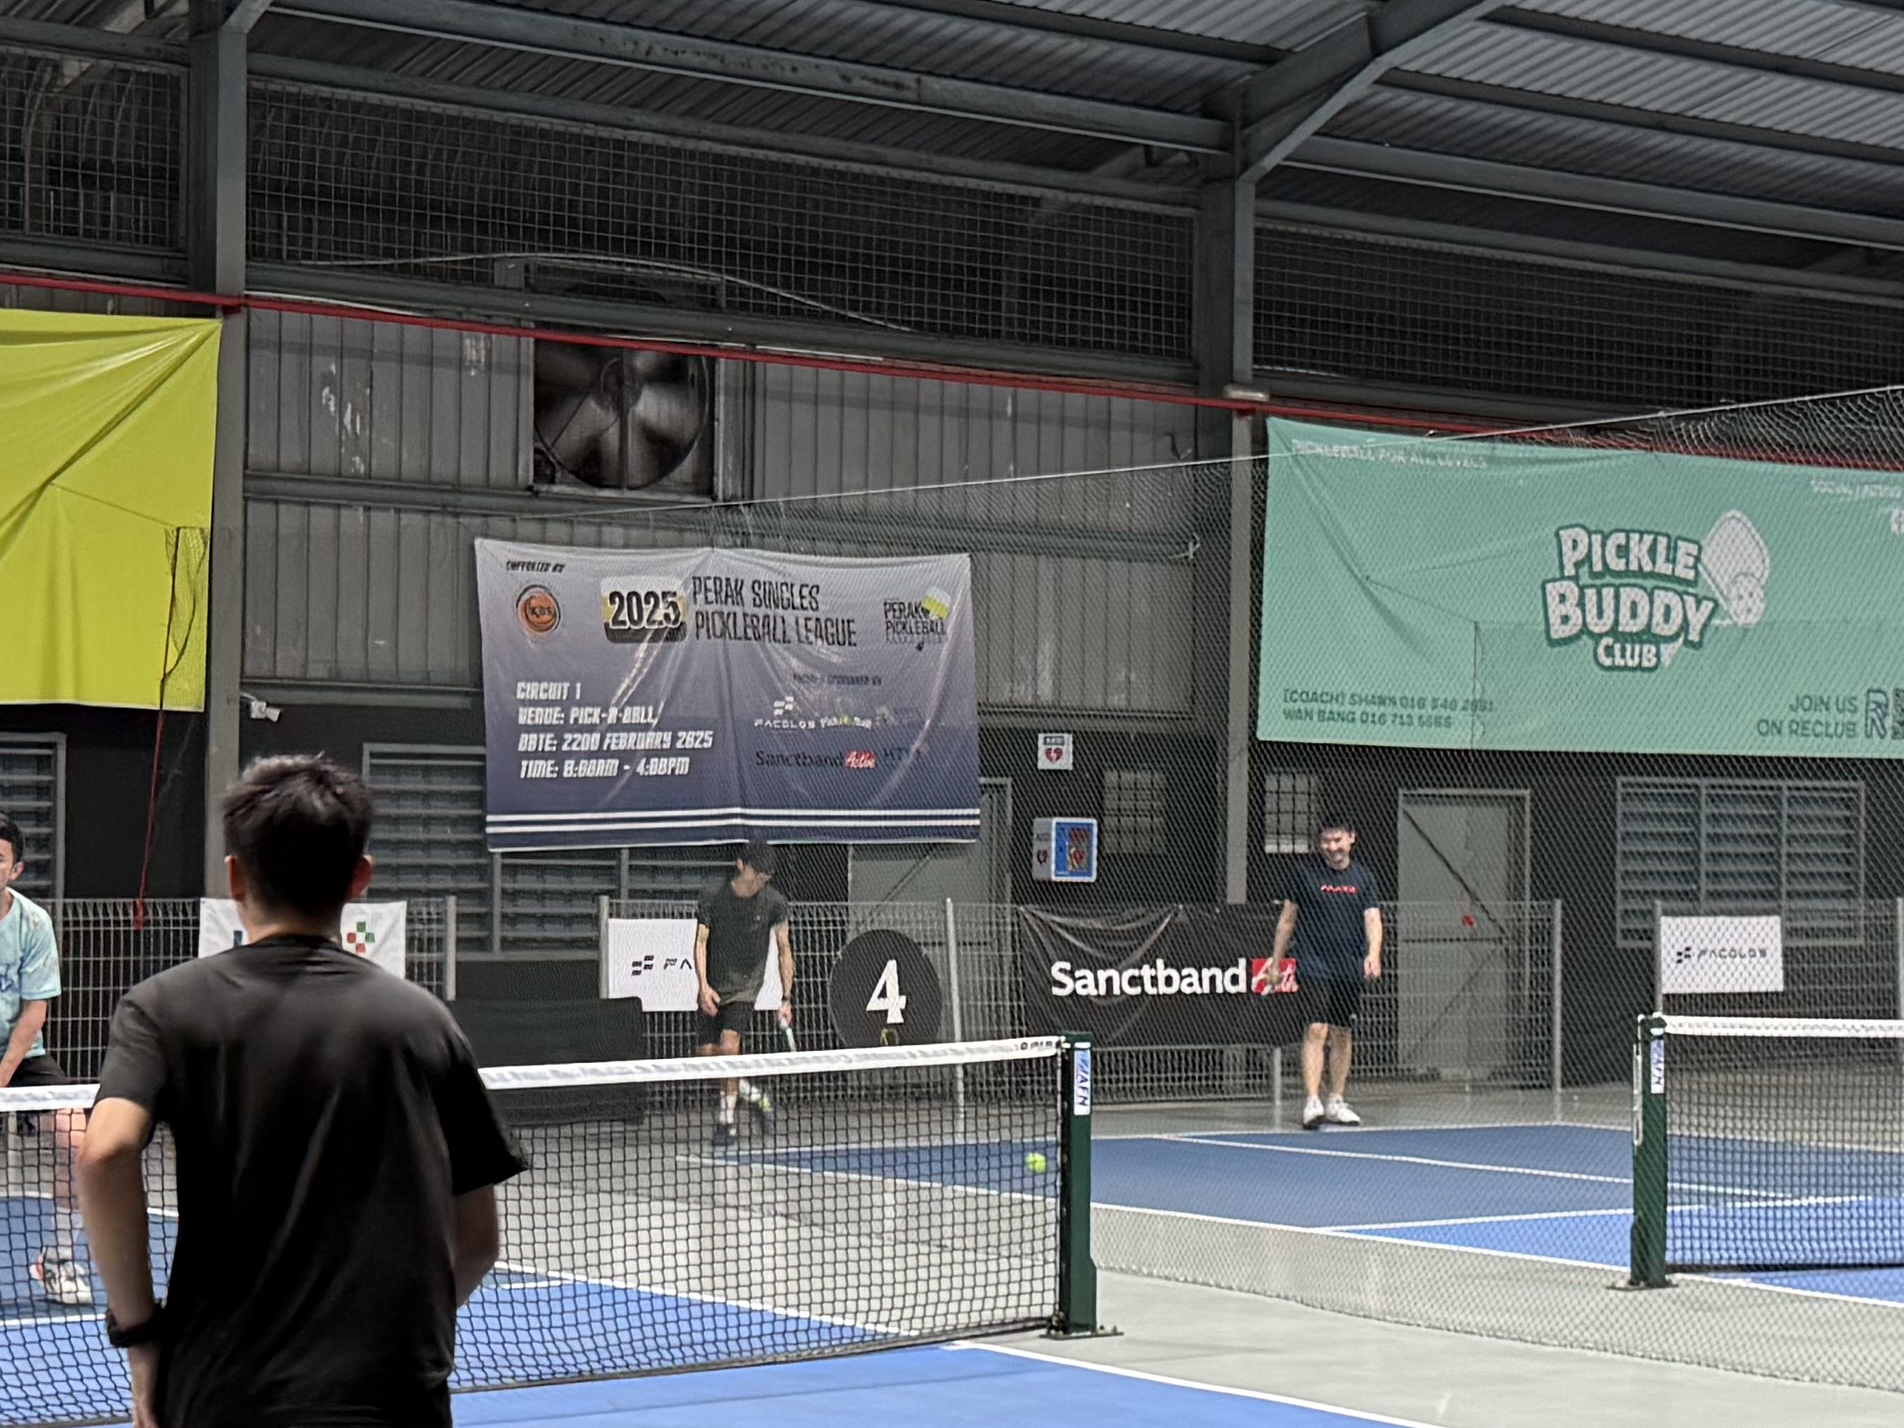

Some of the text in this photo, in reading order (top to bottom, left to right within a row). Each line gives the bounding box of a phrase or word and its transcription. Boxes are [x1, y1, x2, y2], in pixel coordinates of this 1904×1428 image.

[1558, 527, 1700, 580] PICKLE
[609, 590, 681, 628] 2025
[692, 575, 820, 611] PERAK SINGLES
[1545, 579, 1715, 642] BUDDY
[695, 610, 857, 647] PICKLEBALL LEAGUE
[1596, 637, 1657, 668] CLUB
[516, 682, 582, 700] CIRCUIT 1
[1789, 694, 1858, 714] JOIN US
[1757, 719, 1858, 738] ON RECLUB
[520, 759, 558, 778] TIME:
[866, 959, 907, 1025] 4
[1051, 958, 1246, 996] Sanctband
